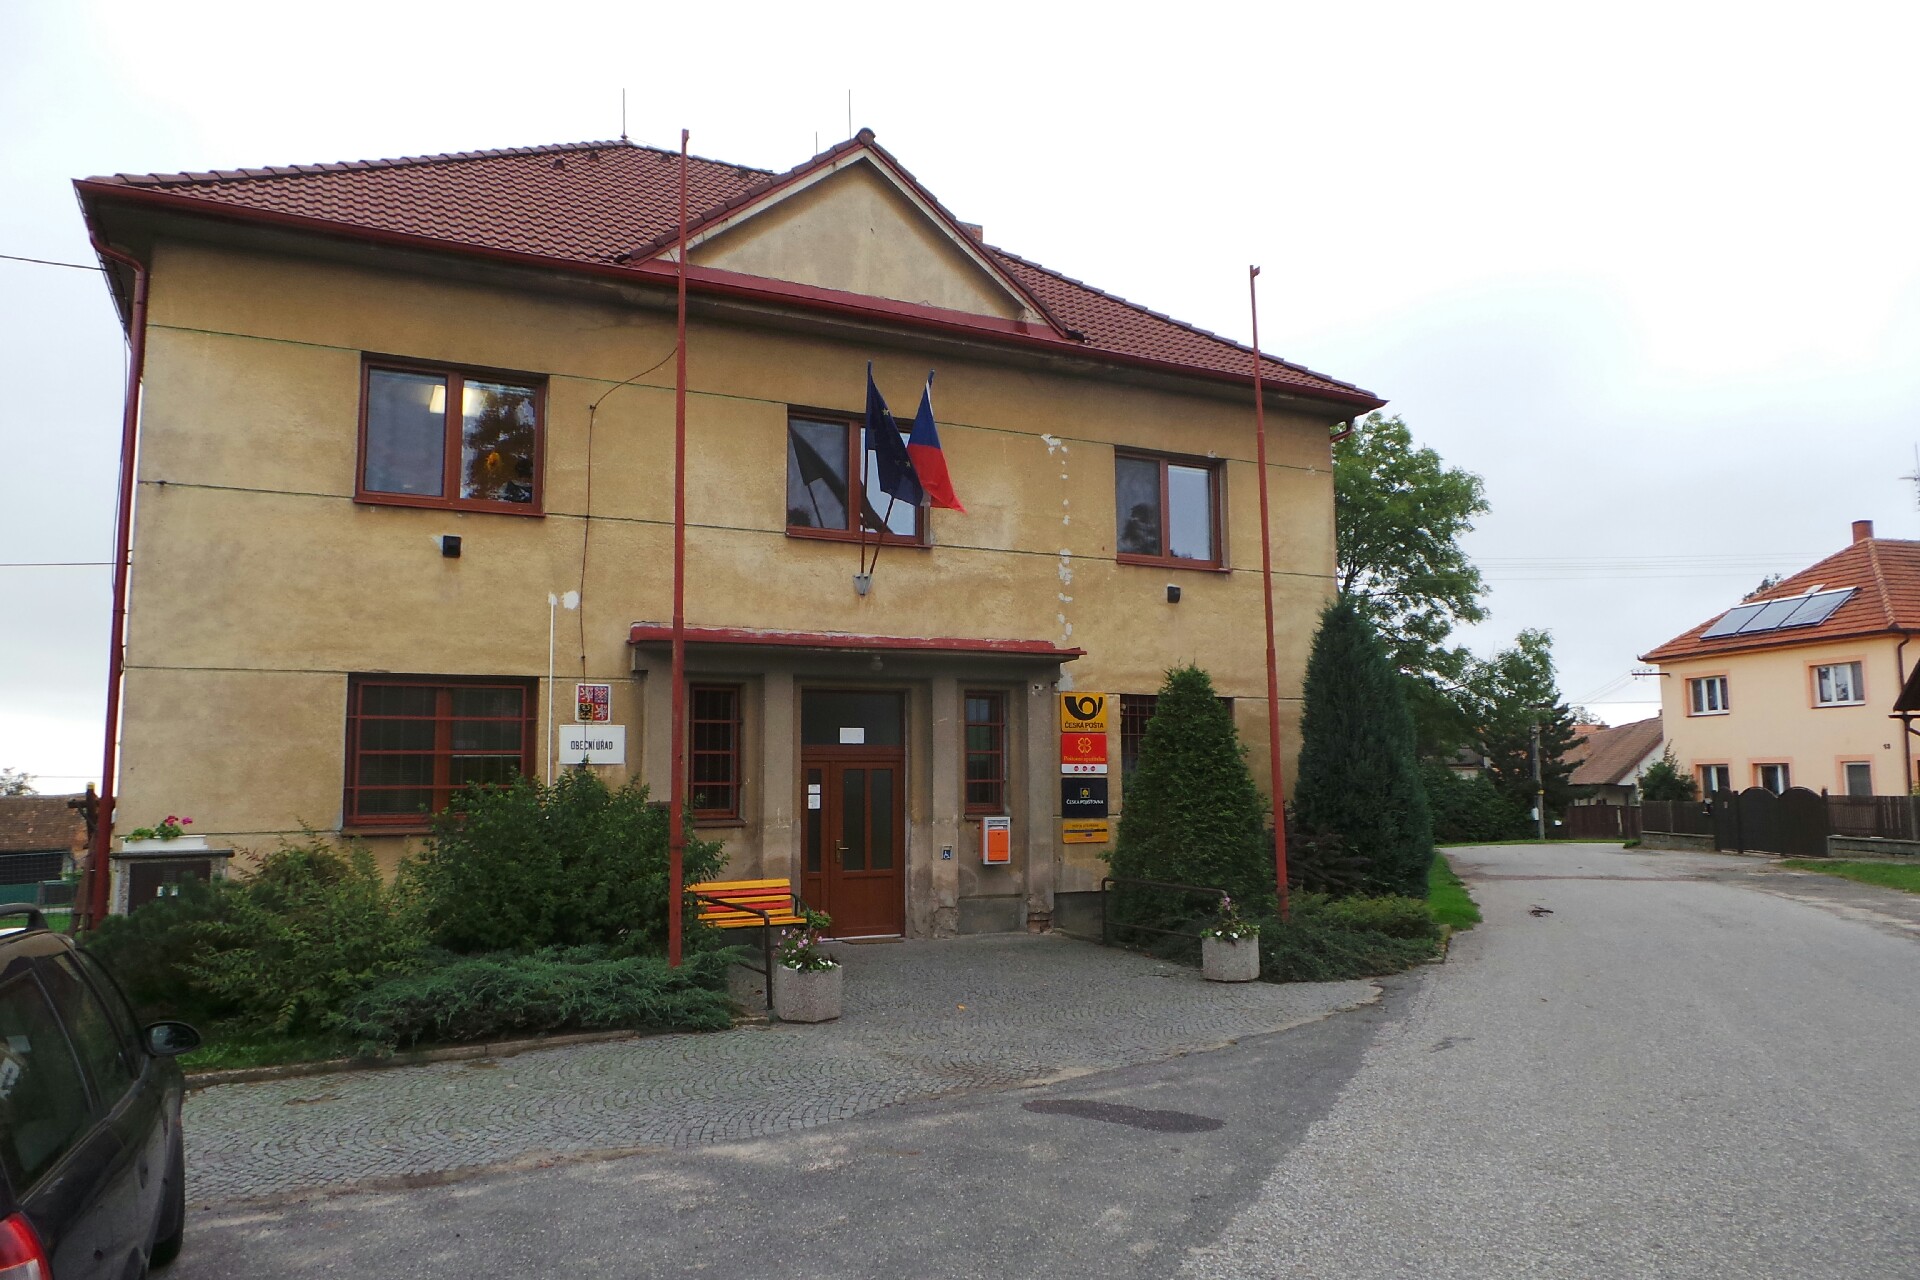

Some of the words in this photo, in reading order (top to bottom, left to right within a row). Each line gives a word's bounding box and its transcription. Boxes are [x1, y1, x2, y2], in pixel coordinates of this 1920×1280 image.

[1065, 721, 1084, 729] ČESKÁ
[1085, 721, 1104, 729] POŠTA
[571, 739, 595, 750] OBECNÍ
